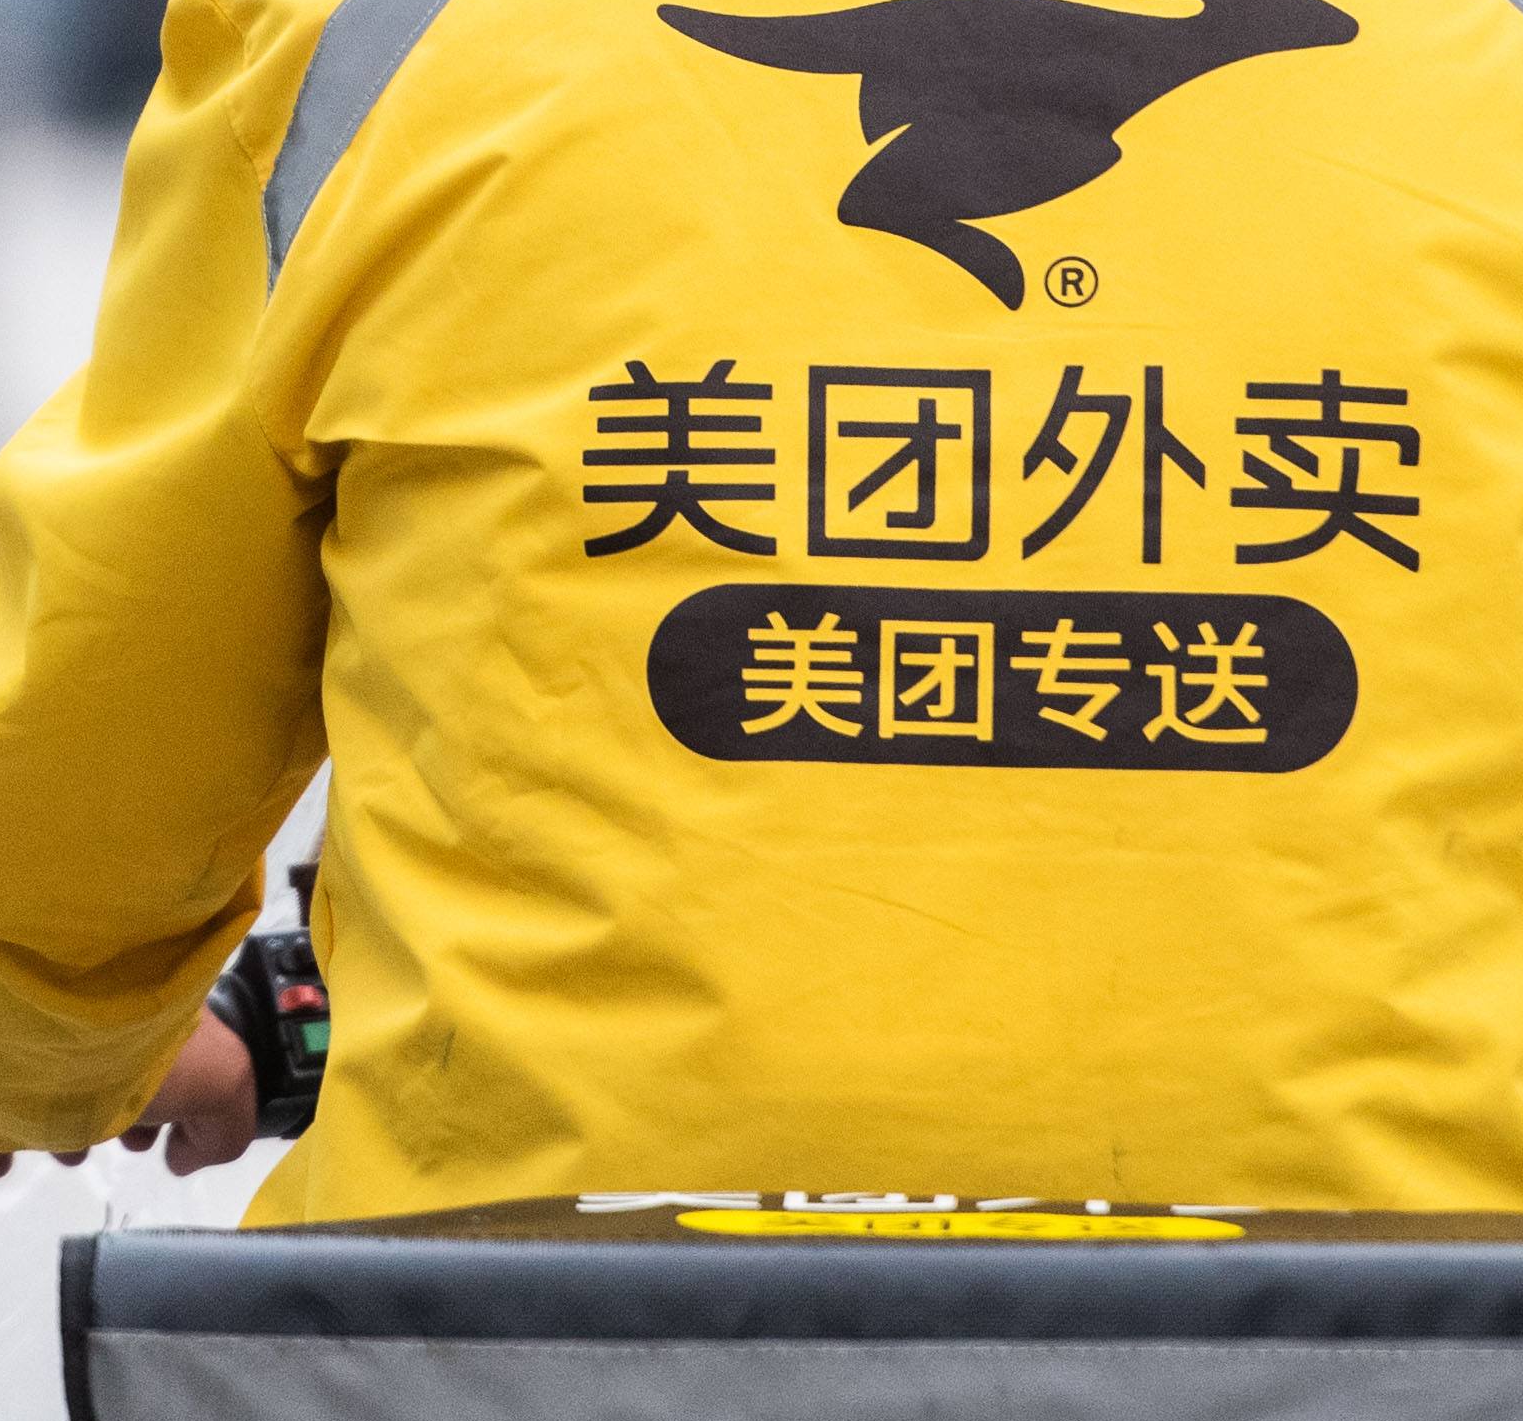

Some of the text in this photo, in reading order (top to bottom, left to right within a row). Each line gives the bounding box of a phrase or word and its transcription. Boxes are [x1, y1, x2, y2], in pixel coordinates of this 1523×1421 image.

[582, 359, 1421, 573] 美团外卖
[740, 611, 1269, 744] 美团专送
